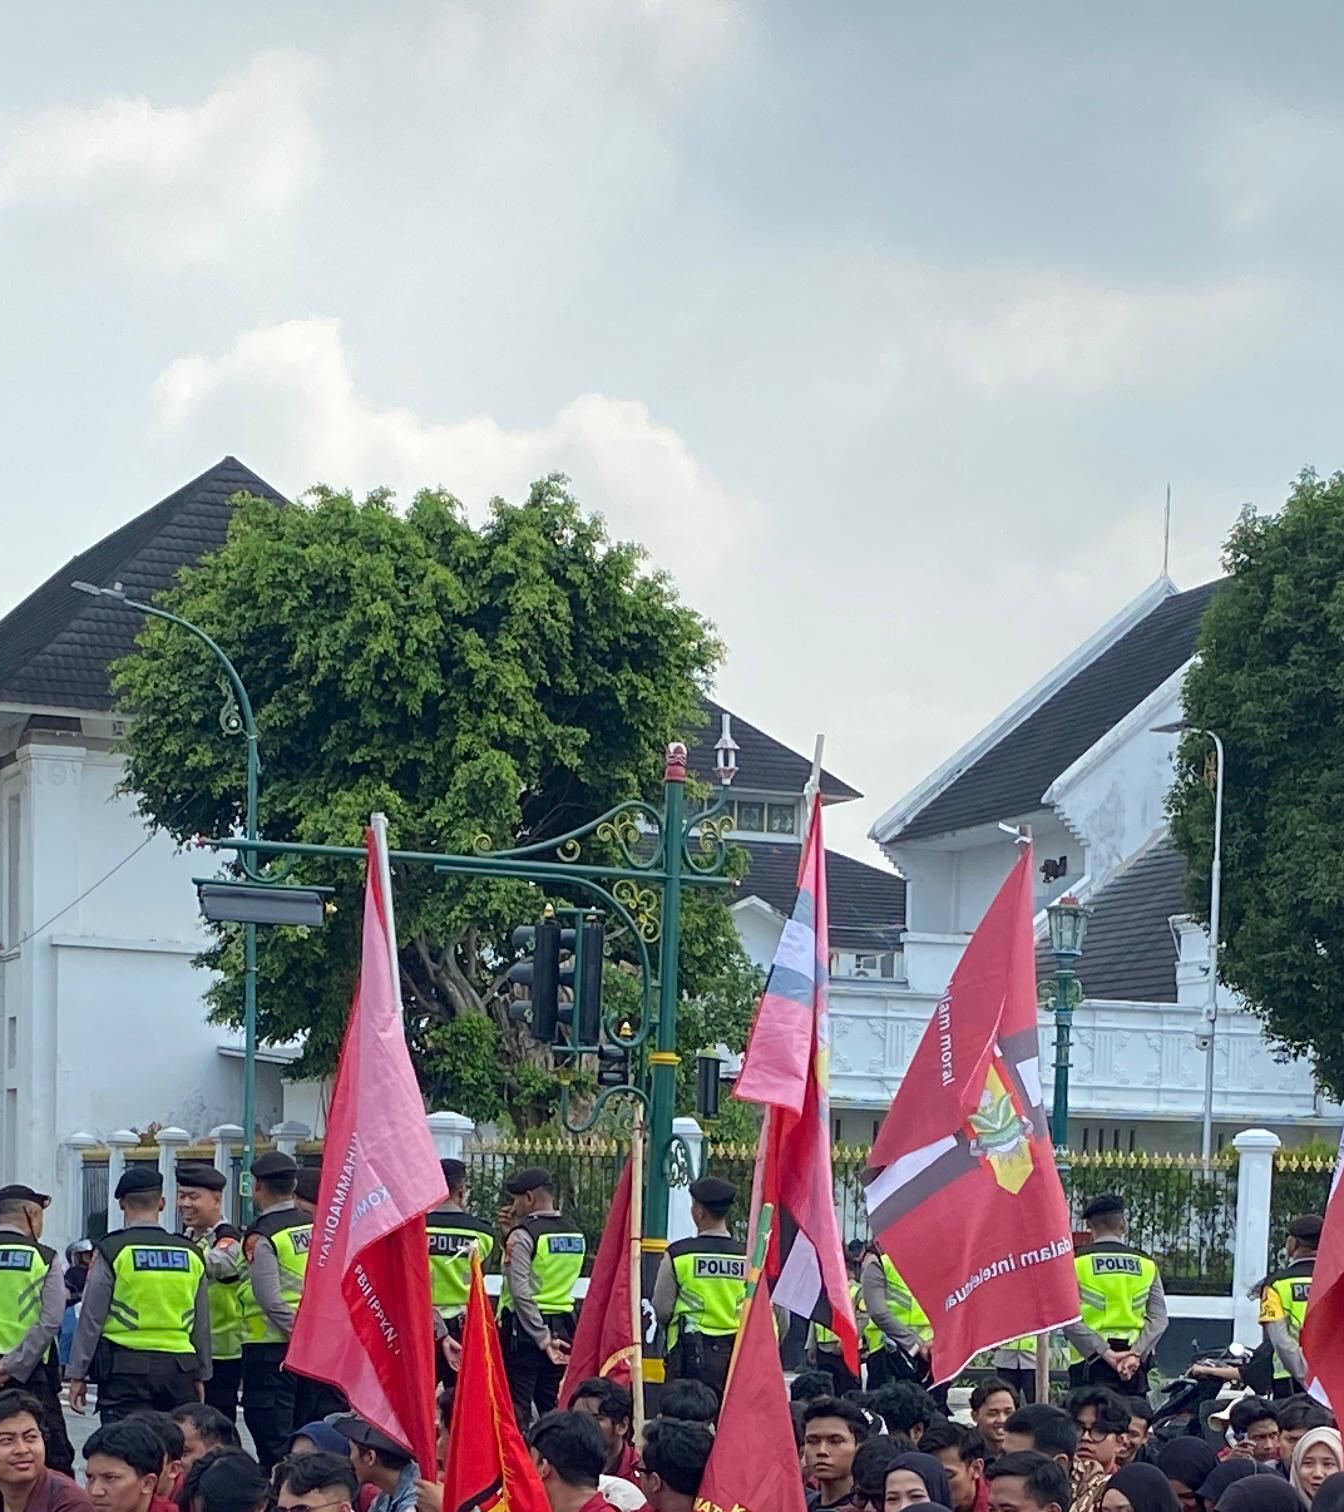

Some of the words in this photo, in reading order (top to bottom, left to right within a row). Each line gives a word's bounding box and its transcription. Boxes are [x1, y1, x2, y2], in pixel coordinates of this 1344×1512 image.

[941, 1035, 955, 1087] moral
[135, 1250, 190, 1268] POLISI
[1095, 1258, 1142, 1274] POLISI
[697, 1260, 745, 1276] POLISI
